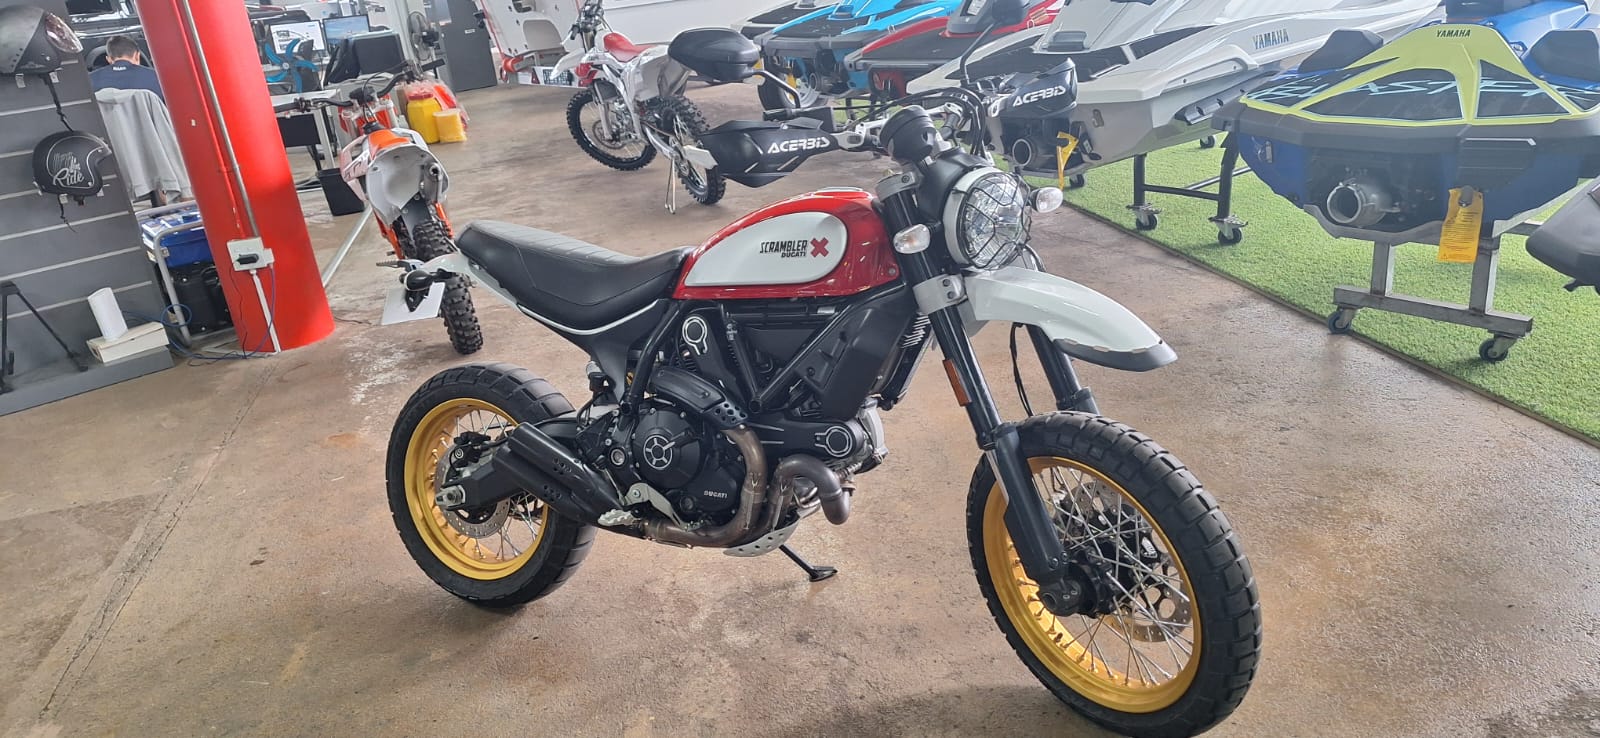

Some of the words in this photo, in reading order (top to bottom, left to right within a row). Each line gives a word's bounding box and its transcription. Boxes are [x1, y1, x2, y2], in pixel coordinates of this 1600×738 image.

[1252, 29, 1289, 49] YAMAHA
[1436, 29, 1471, 38] YAMAHA
[760, 239, 807, 253] SCRAMBLER
[703, 490, 728, 499] DUCATI
